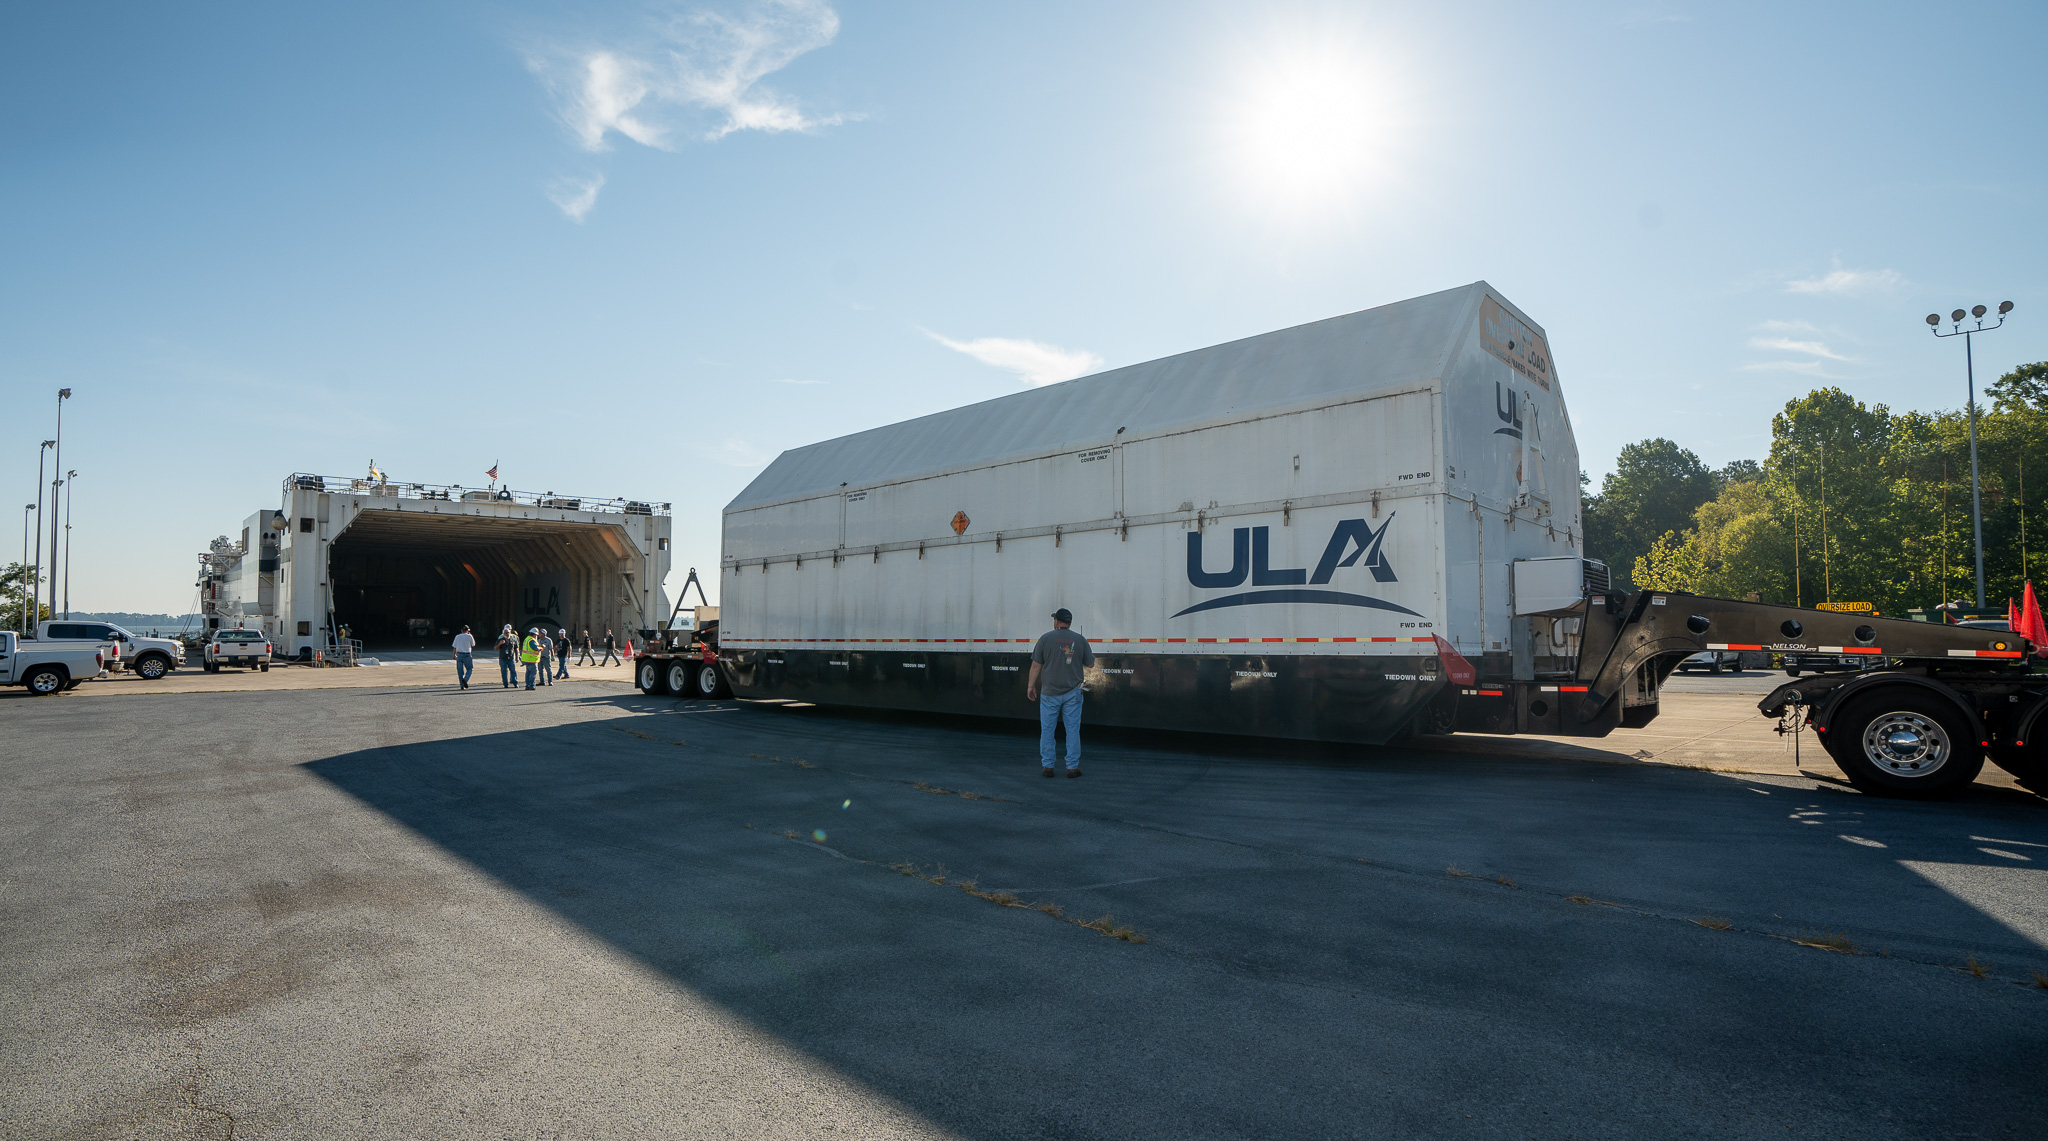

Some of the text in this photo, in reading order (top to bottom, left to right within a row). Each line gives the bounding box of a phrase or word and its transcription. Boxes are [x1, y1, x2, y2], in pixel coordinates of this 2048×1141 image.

[1499, 309, 1533, 347] CAUTION
[1485, 317, 1546, 374] OVERSZE LOAD
[1511, 358, 1526, 375] MAKES
[1527, 368, 1537, 382] WIDE
[1088, 448, 1111, 456] REMOVING
[1417, 471, 1431, 479] END
[1187, 510, 1398, 588] ULA
[524, 585, 561, 615] ULA
[1852, 602, 1871, 611] LOAD
